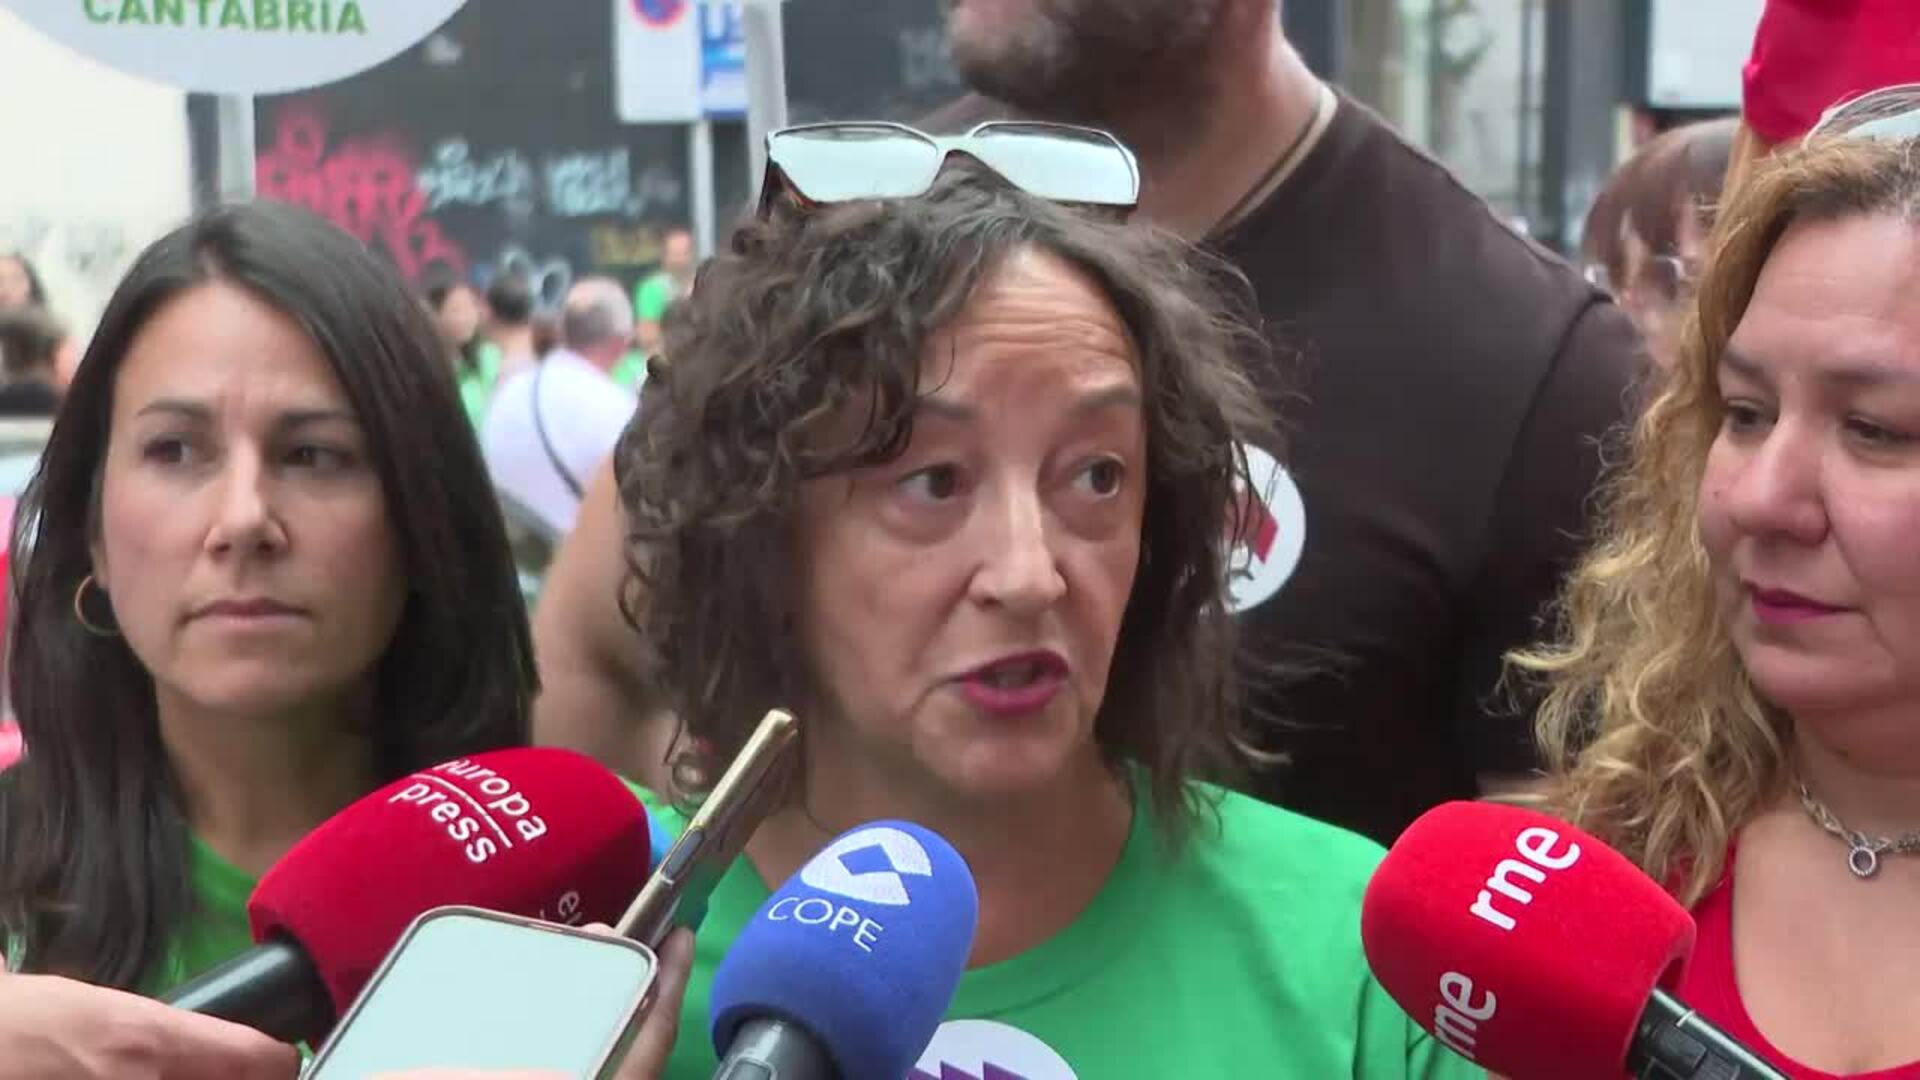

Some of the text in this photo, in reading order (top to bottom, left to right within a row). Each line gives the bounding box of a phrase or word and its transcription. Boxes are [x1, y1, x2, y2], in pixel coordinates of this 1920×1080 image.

[83, 0, 367, 34] CANTABRIA
[388, 783, 497, 863] press
[1470, 827, 1581, 930] rne
[767, 897, 883, 953] COPE
